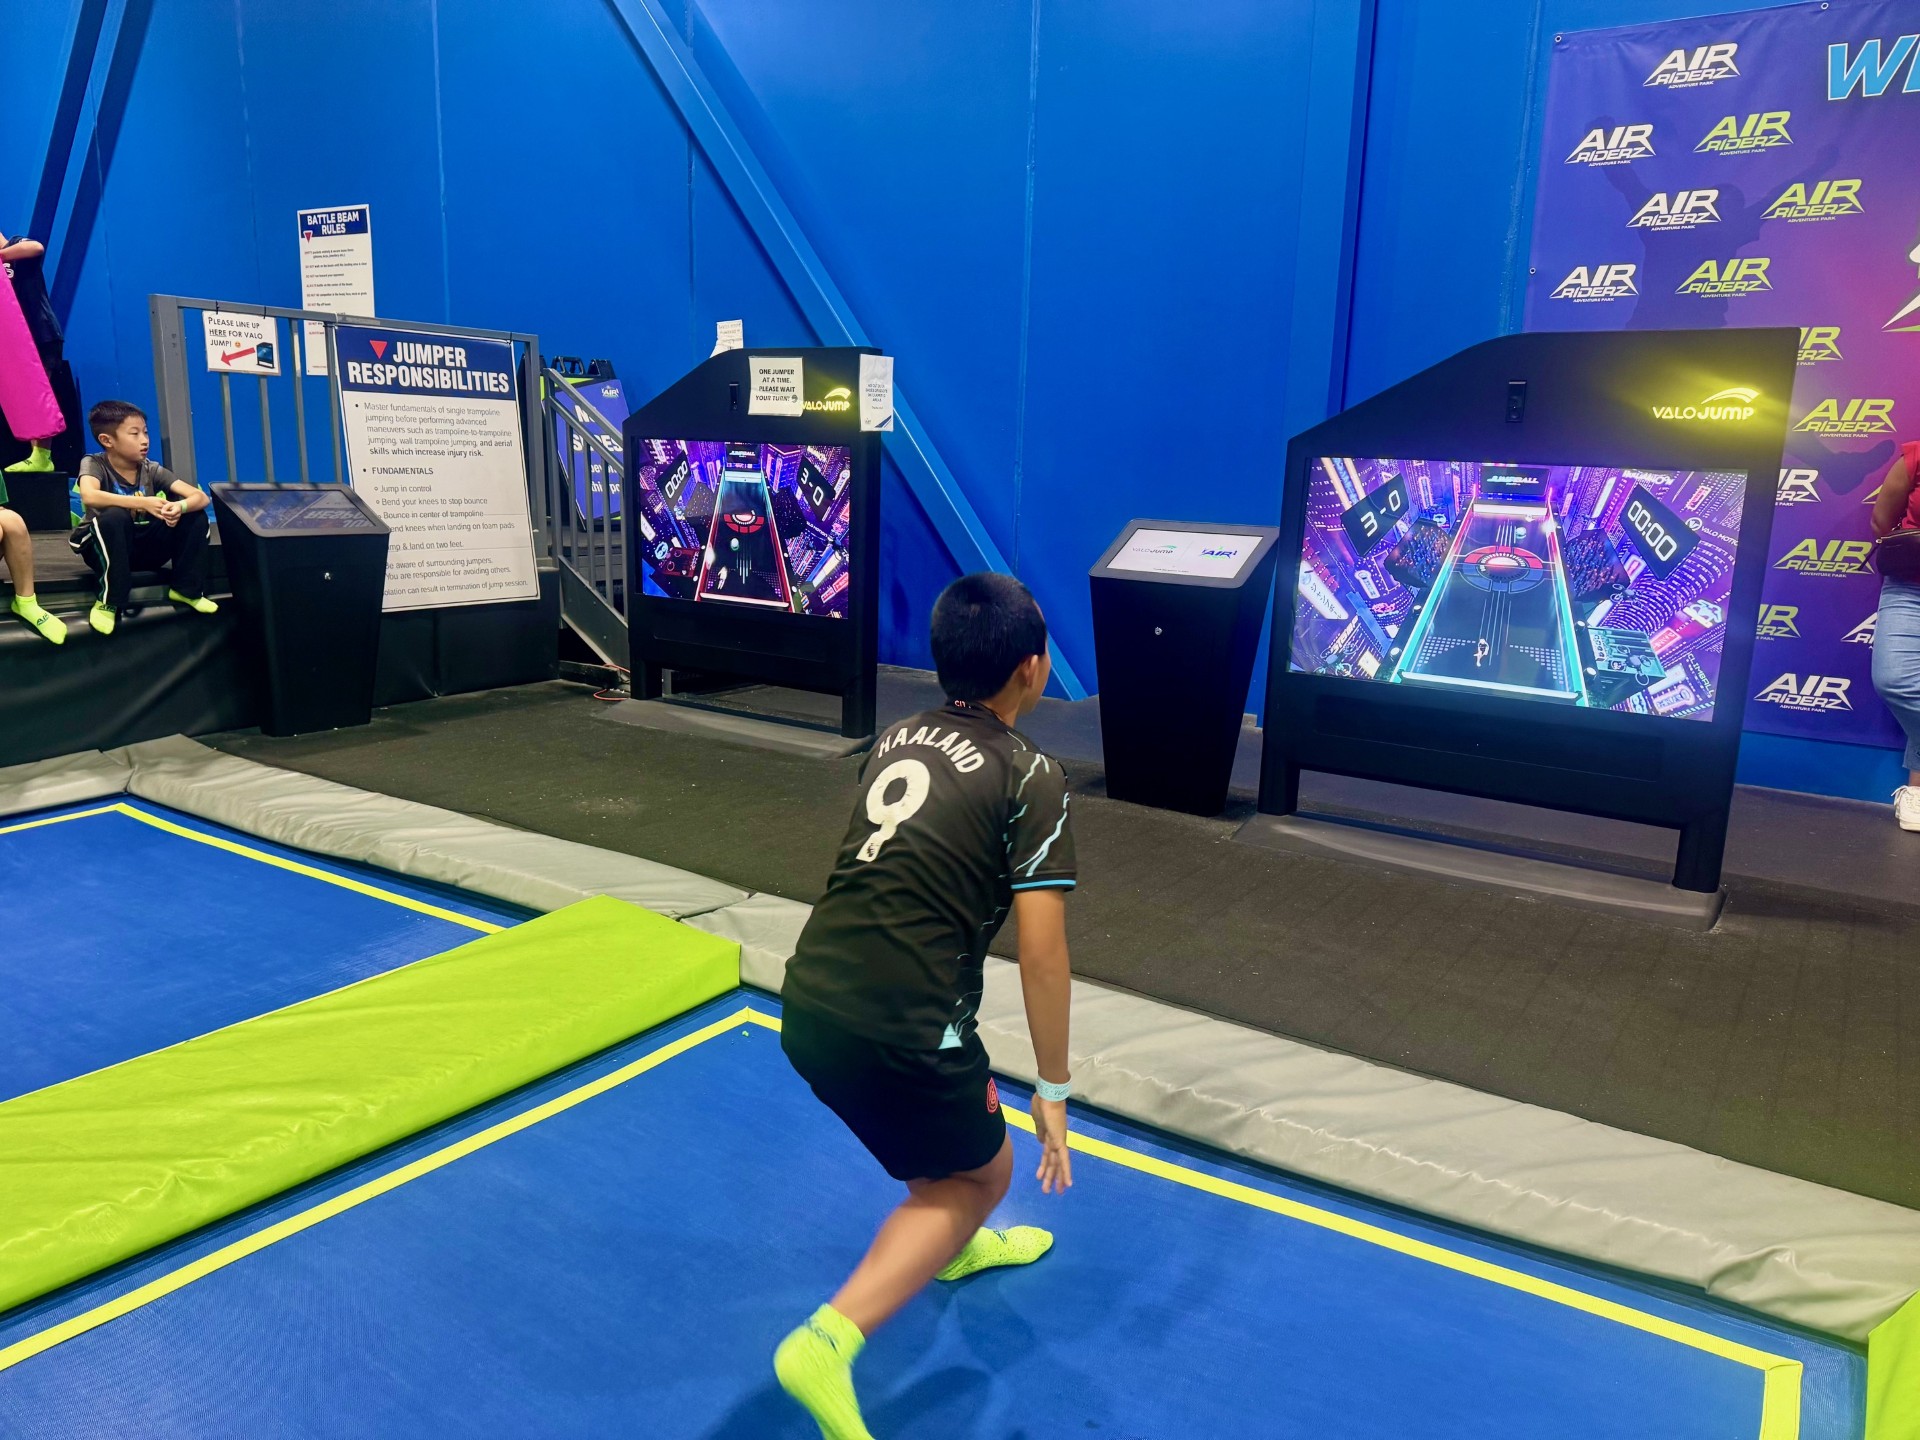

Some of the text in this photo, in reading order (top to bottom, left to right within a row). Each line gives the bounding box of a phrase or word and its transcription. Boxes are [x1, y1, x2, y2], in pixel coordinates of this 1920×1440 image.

[1643, 43, 1740, 79] AIR
[1828, 33, 1920, 100] W
[1652, 67, 1734, 86] RIDERZ
[1693, 111, 1793, 147] AIR
[1564, 124, 1656, 157] AIR
[1704, 134, 1789, 152] RIDERZ
[1575, 147, 1651, 163] RIDERZ
[1760, 179, 1864, 216] AIR
[1626, 189, 1721, 222] AIR
[1772, 202, 1860, 219] RIDERZ
[307, 211, 359, 225] BATTLE BEAM
[1636, 211, 1715, 228] RIDERZ
[322, 223, 346, 235] RULES
[1550, 263, 1639, 294] AIR
[1675, 257, 1773, 290] AIR
[1559, 285, 1633, 299] RIDERZ
[1686, 280, 1767, 295] RIDERZ
[236, 320, 250, 328] LINE
[209, 328, 227, 337] HERE
[228, 330, 242, 338] FOR
[210, 339, 232, 347] JUMP!
[393, 341, 467, 368] JUMPER
[347, 362, 509, 393] RESPONSIBILITIES
[364, 402, 389, 411] Master
[390, 403, 437, 413] fundamentals
[446, 406, 466, 416] single
[466, 407, 501, 417] trampoline
[1792, 399, 1897, 430] AIR
[365, 415, 393, 424] jumping
[395, 414, 417, 423] before
[419, 416, 455, 426] performing
[1803, 420, 1890, 432] RIDERZ
[367, 426, 405, 434] maneuvers
[407, 426, 423, 434] such
[435, 427, 512, 437] trampoline-to-trampoline
[414, 437, 449, 447] trampoline
[479, 439, 493, 447] and
[494, 439, 513, 447] aerial
[370, 446, 484, 458] skills which increase injury risk.
[372, 467, 433, 475] FUNDAMENTALS
[665, 460, 688, 499] 00:00
[380, 485, 399, 493] Jump
[402, 499, 416, 507] your
[418, 497, 439, 505] knees
[448, 498, 462, 506] stop
[383, 511, 410, 519] Bounce
[450, 510, 484, 519] trampoline
[390, 524, 404, 533] end
[405, 523, 426, 532] knees
[427, 523, 446, 531] when
[447, 522, 471, 532] landing
[481, 522, 498, 530] foam
[500, 522, 515, 530] pads
[1627, 500, 1677, 561] 00:00
[409, 541, 424, 549] land
[1772, 538, 1874, 571] AIR
[395, 561, 416, 569] aware
[426, 558, 465, 568] surrounding
[1784, 559, 1868, 573] RIDERZ
[387, 571, 399, 580] You
[400, 572, 412, 580] are
[412, 569, 451, 580] responsible
[463, 567, 490, 577] avoiding
[407, 587, 419, 595] can
[420, 585, 438, 594] result
[446, 582, 480, 592] termination
[481, 581, 488, 589] of
[488, 580, 504, 590] jump
[1753, 672, 1853, 707] AIR
[1765, 692, 1847, 710] RIDERZ
[878, 726, 985, 773] HAALAND
[855, 758, 930, 863] 9
